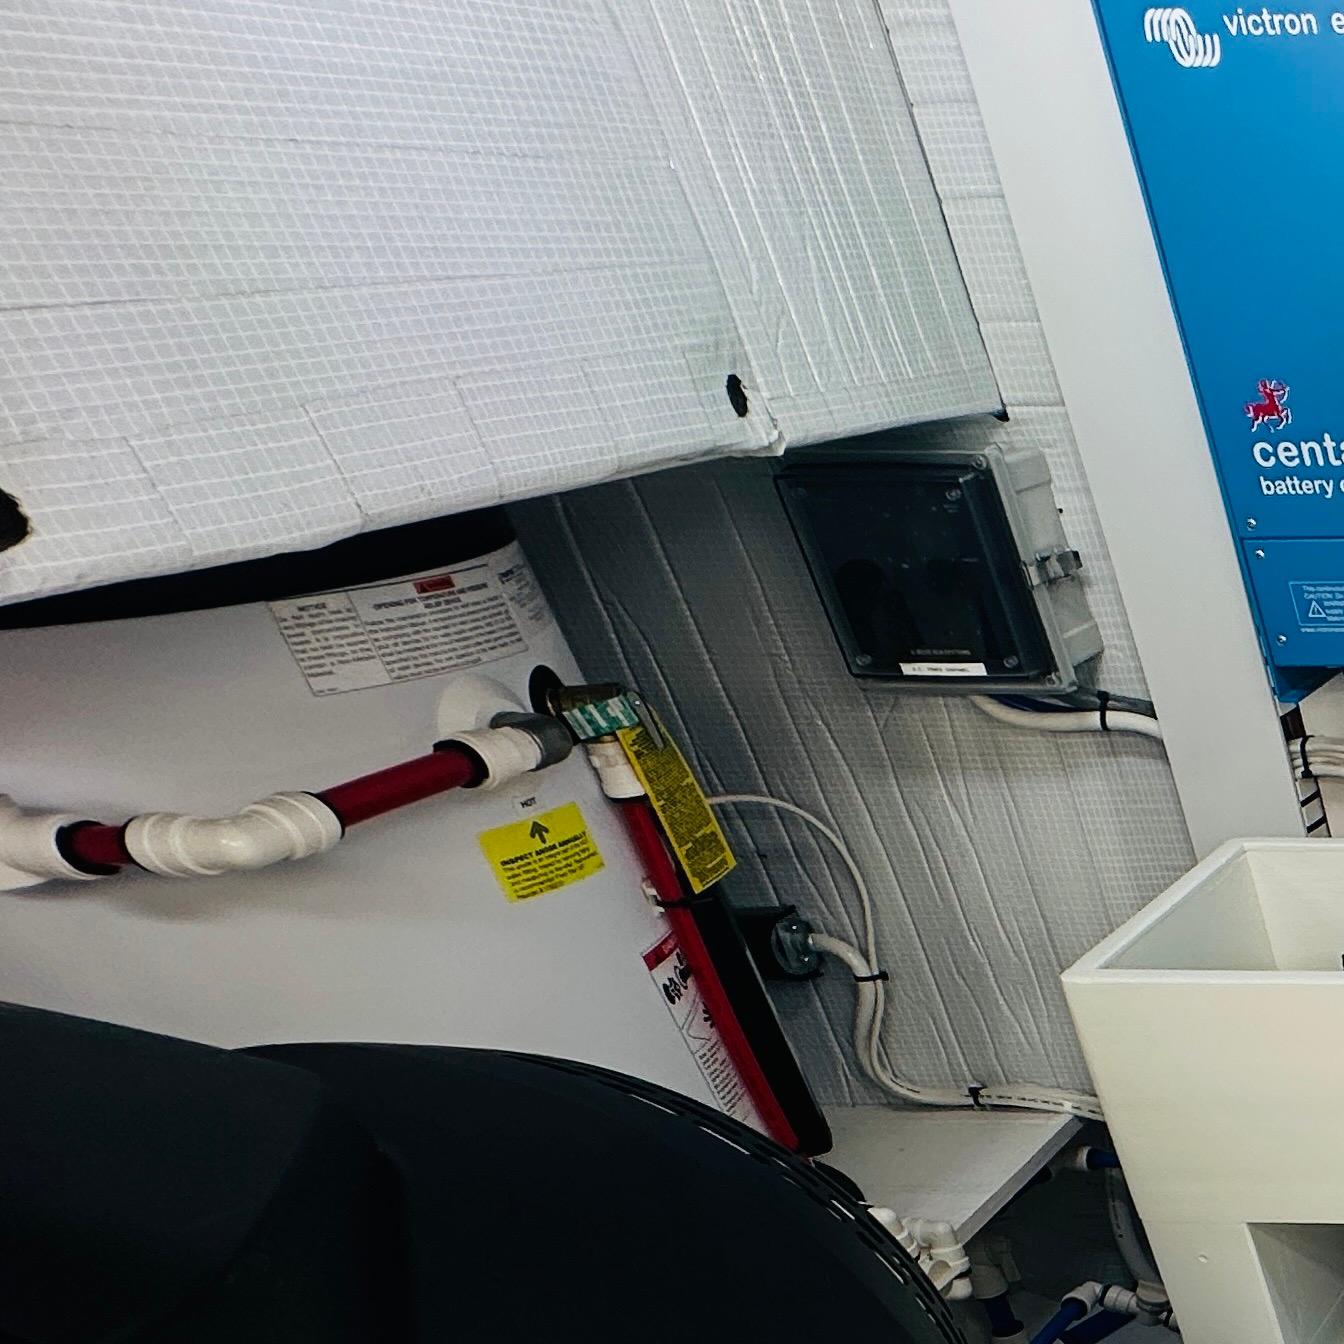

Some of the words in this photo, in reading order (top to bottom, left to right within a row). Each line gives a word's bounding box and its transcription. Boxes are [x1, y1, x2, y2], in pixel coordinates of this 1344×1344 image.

[1223, 8, 1318, 36] victron
[1260, 476, 1334, 498] battery
[520, 797, 537, 808] HOT
